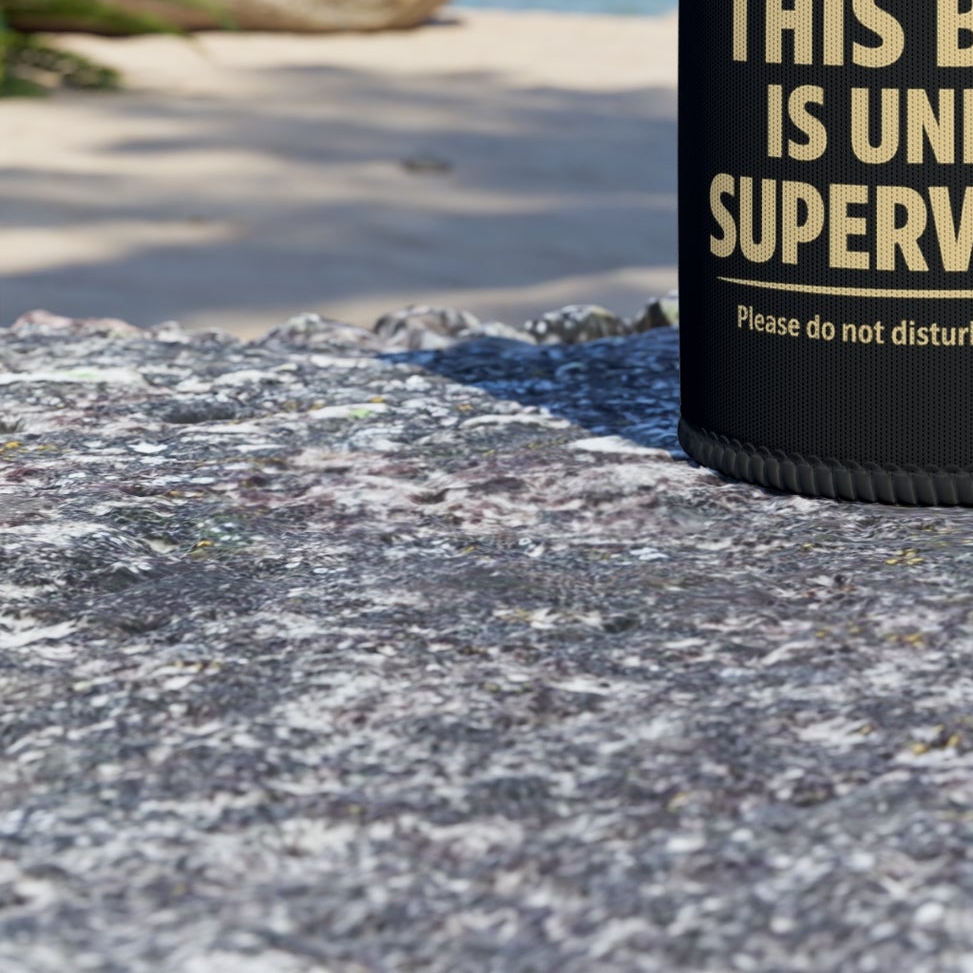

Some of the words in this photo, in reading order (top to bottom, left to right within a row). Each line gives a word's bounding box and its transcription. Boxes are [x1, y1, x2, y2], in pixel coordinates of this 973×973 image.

[767, 84, 828, 161] IS
[737, 305, 800, 337] Please
[806, 314, 835, 340] do
[842, 320, 884, 345] not
